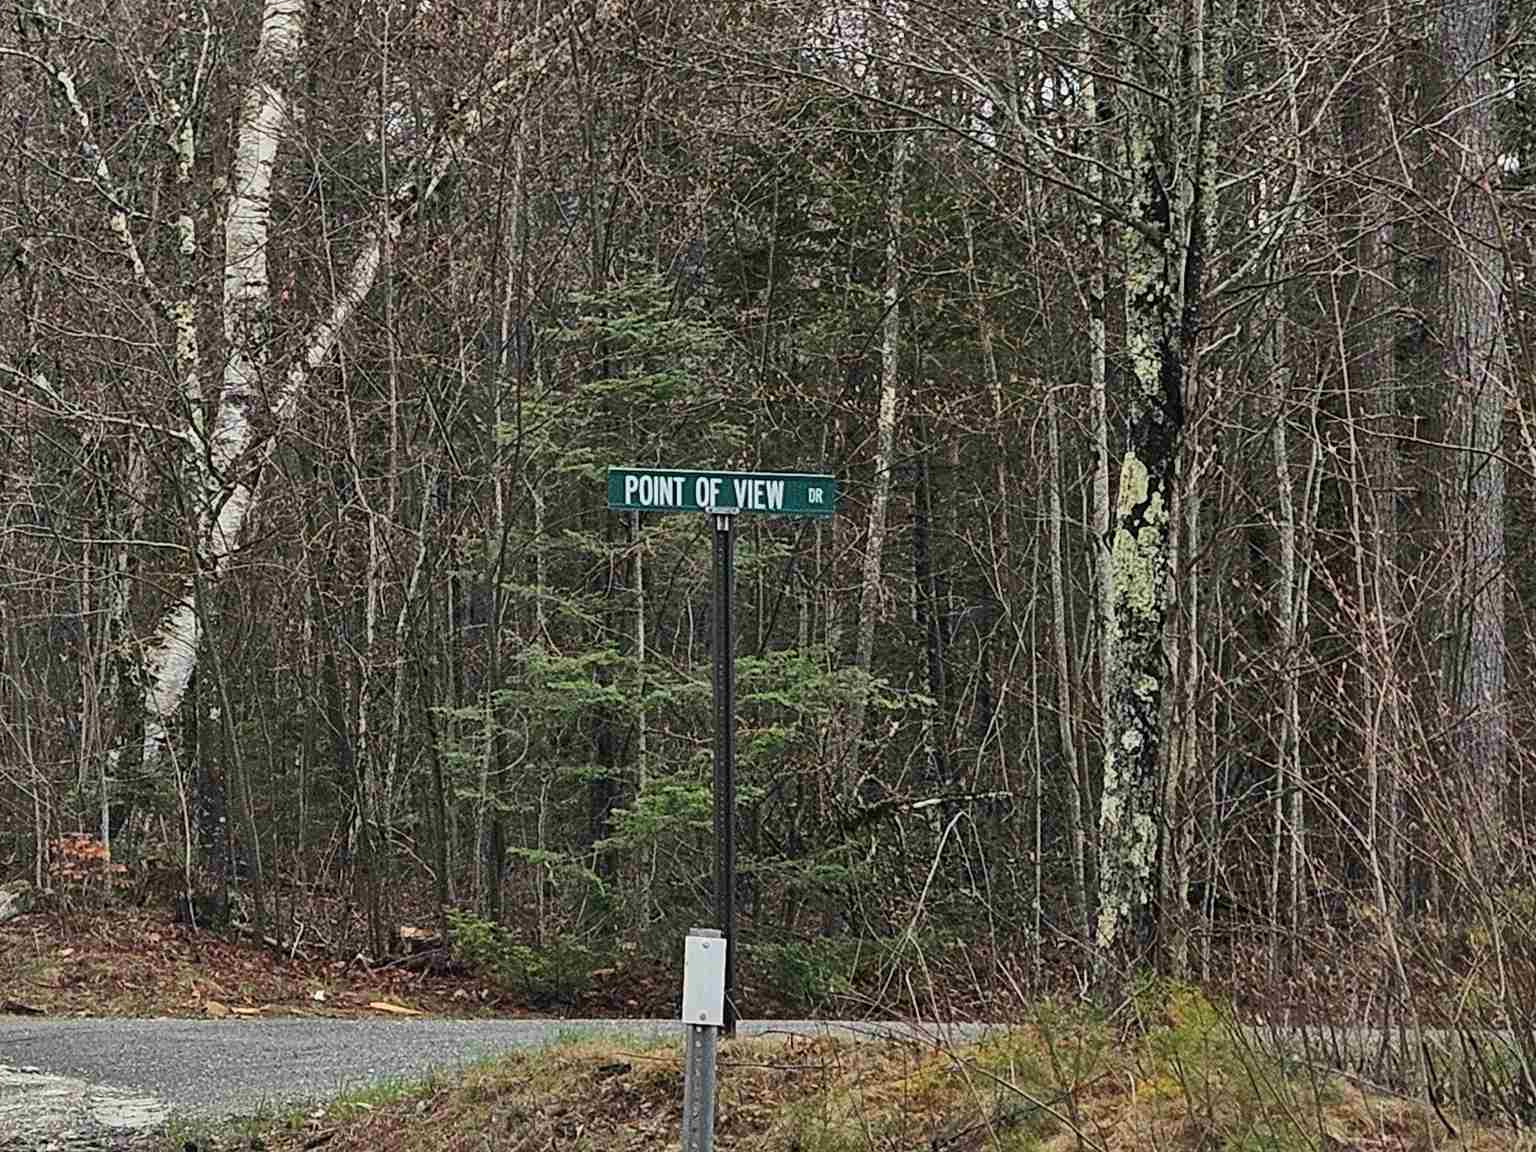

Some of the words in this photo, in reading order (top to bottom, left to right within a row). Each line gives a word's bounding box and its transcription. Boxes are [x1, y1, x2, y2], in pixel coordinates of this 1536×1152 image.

[624, 475, 685, 507] POINT
[695, 477, 722, 508] OF
[733, 479, 784, 510] VIEW
[808, 488, 823, 504] DR
